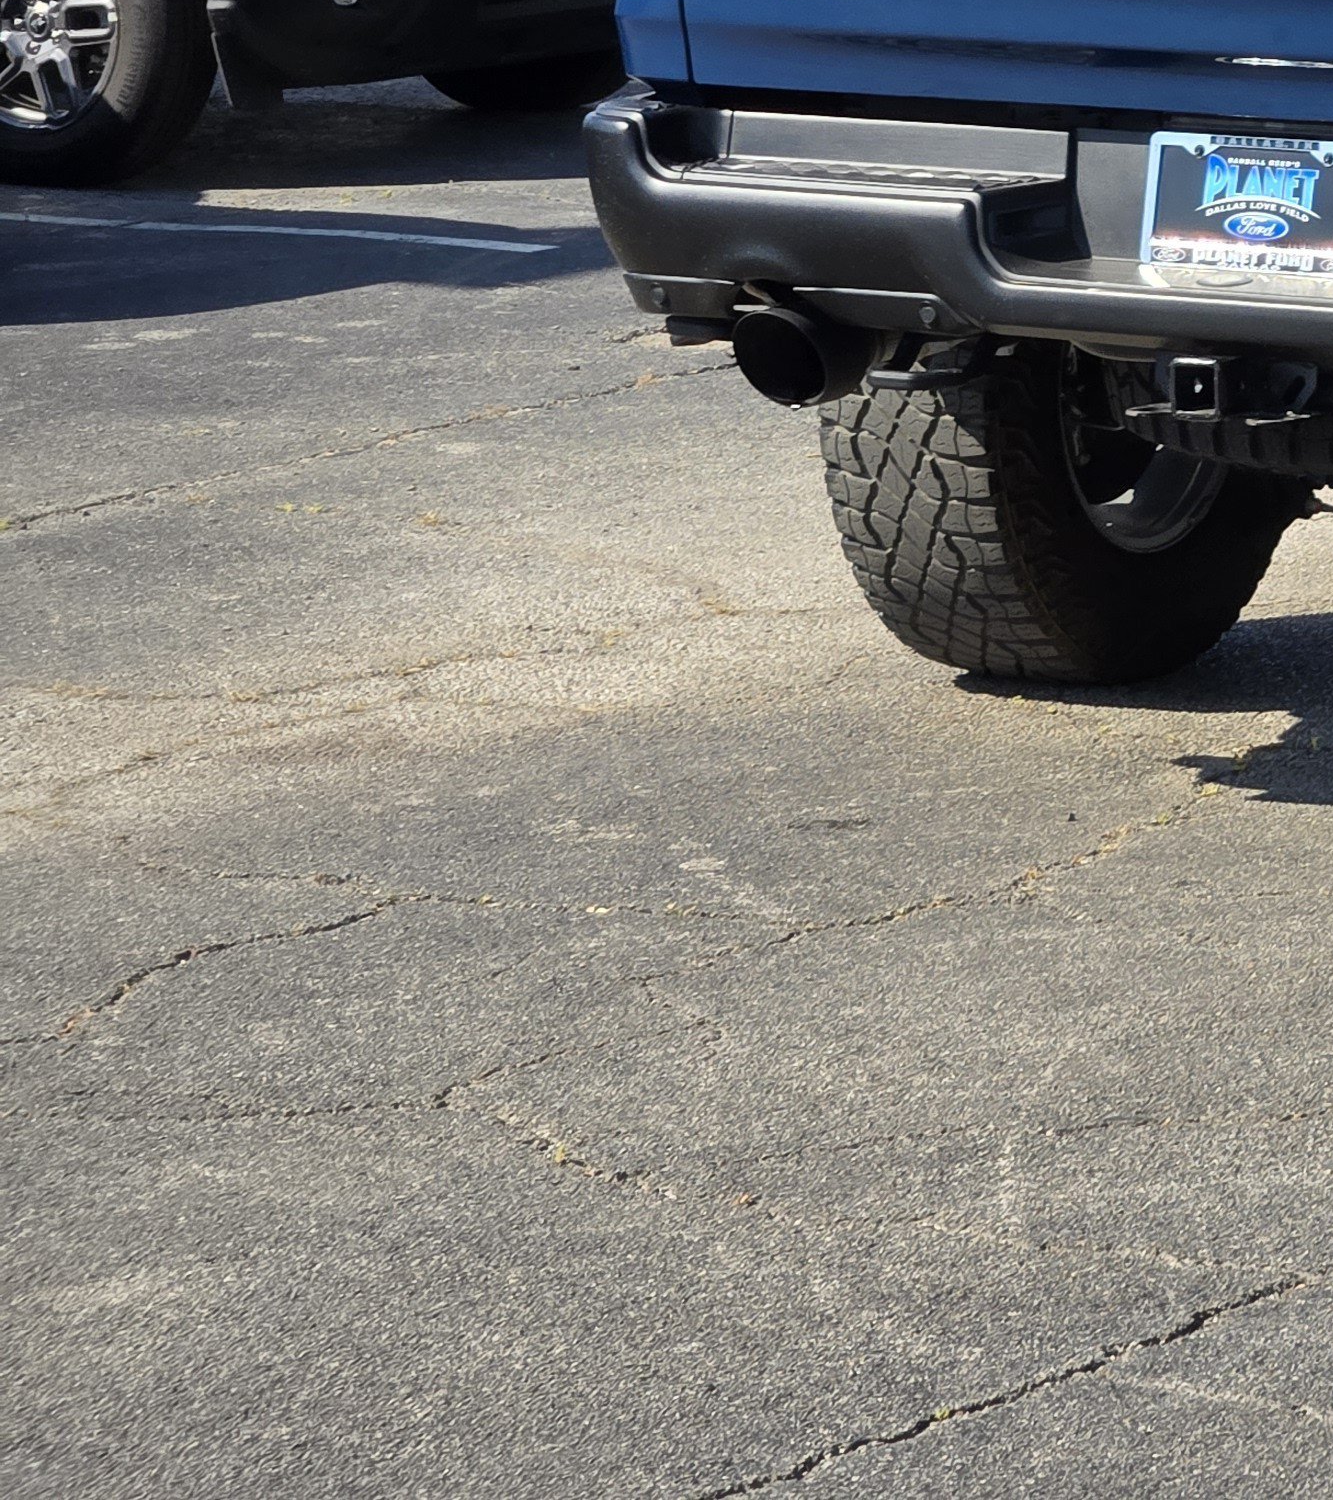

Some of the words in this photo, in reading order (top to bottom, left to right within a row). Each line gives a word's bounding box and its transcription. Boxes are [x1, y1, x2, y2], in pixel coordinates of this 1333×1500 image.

[1202, 153, 1319, 213] PLANET
[1249, 201, 1277, 212] LOVE
[1236, 215, 1277, 237] Ford
